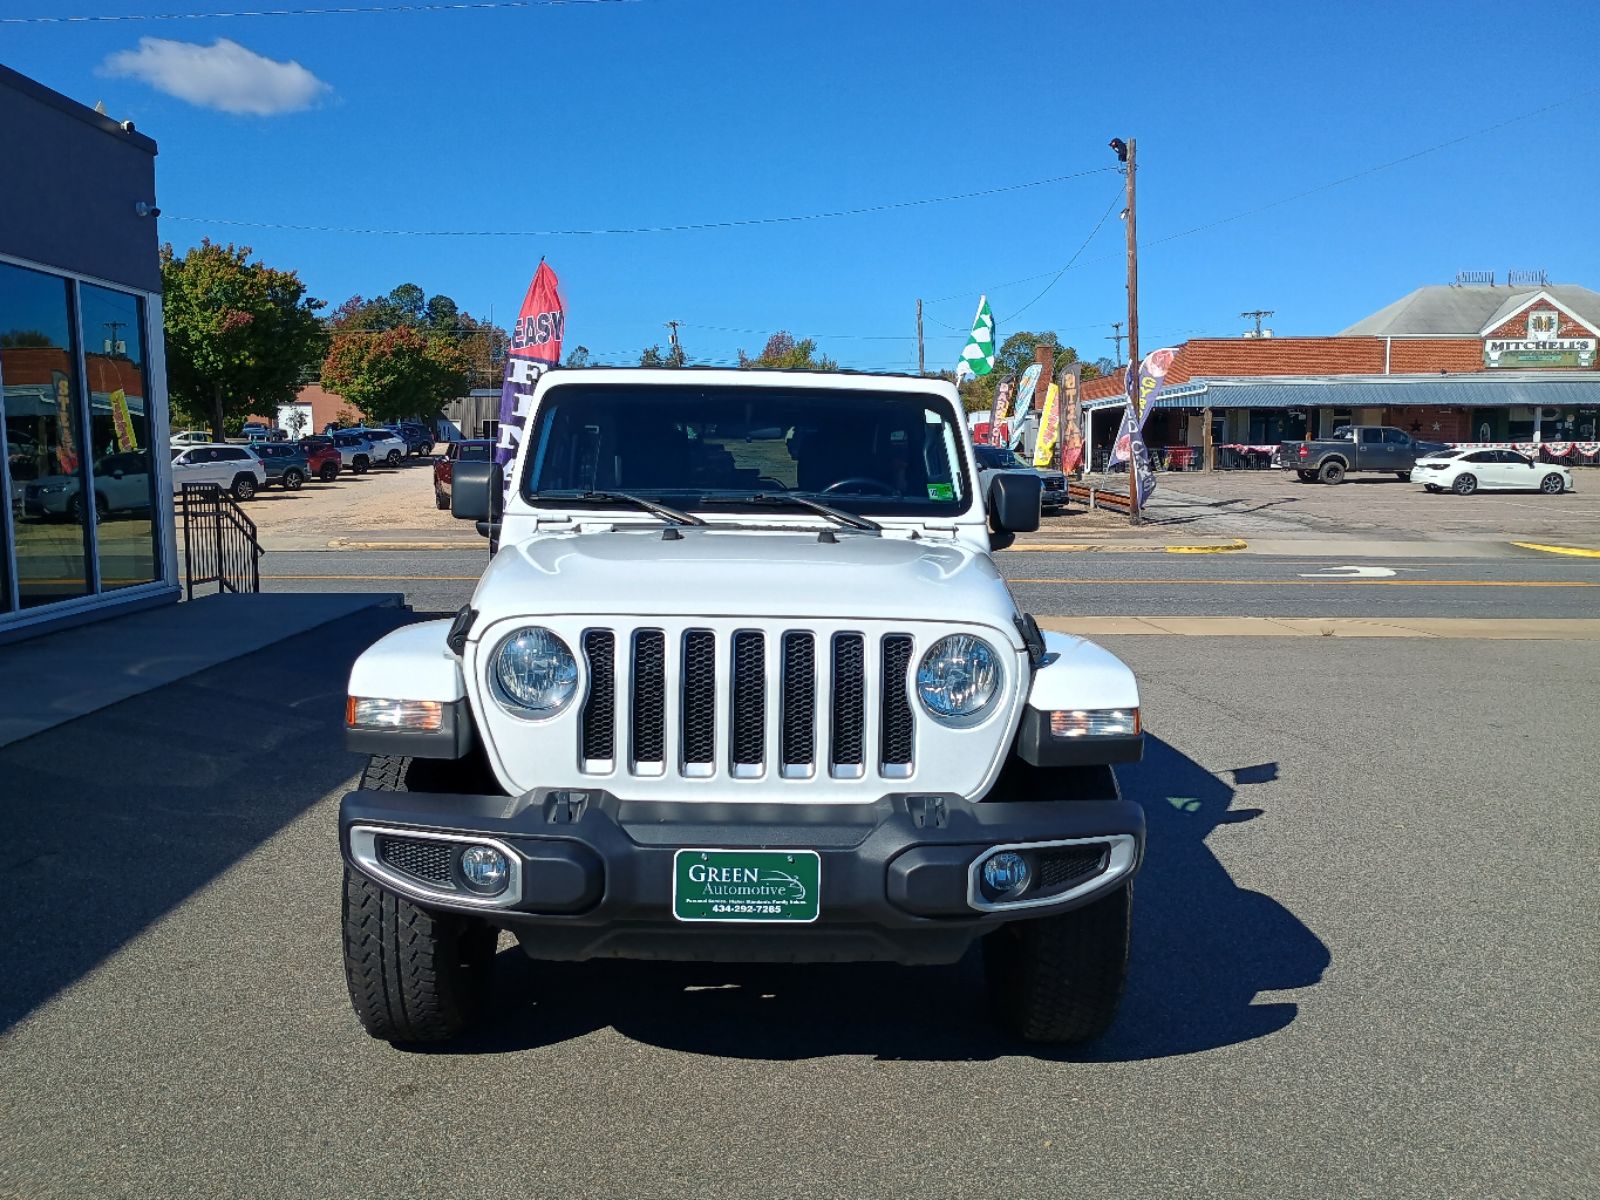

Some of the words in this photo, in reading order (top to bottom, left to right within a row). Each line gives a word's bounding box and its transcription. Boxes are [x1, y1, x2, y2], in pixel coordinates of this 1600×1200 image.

[511, 311, 565, 351] EASY
[1490, 341, 1590, 352] MITCHELL'S
[688, 864, 759, 883] GREEN
[702, 882, 786, 896] Automotive
